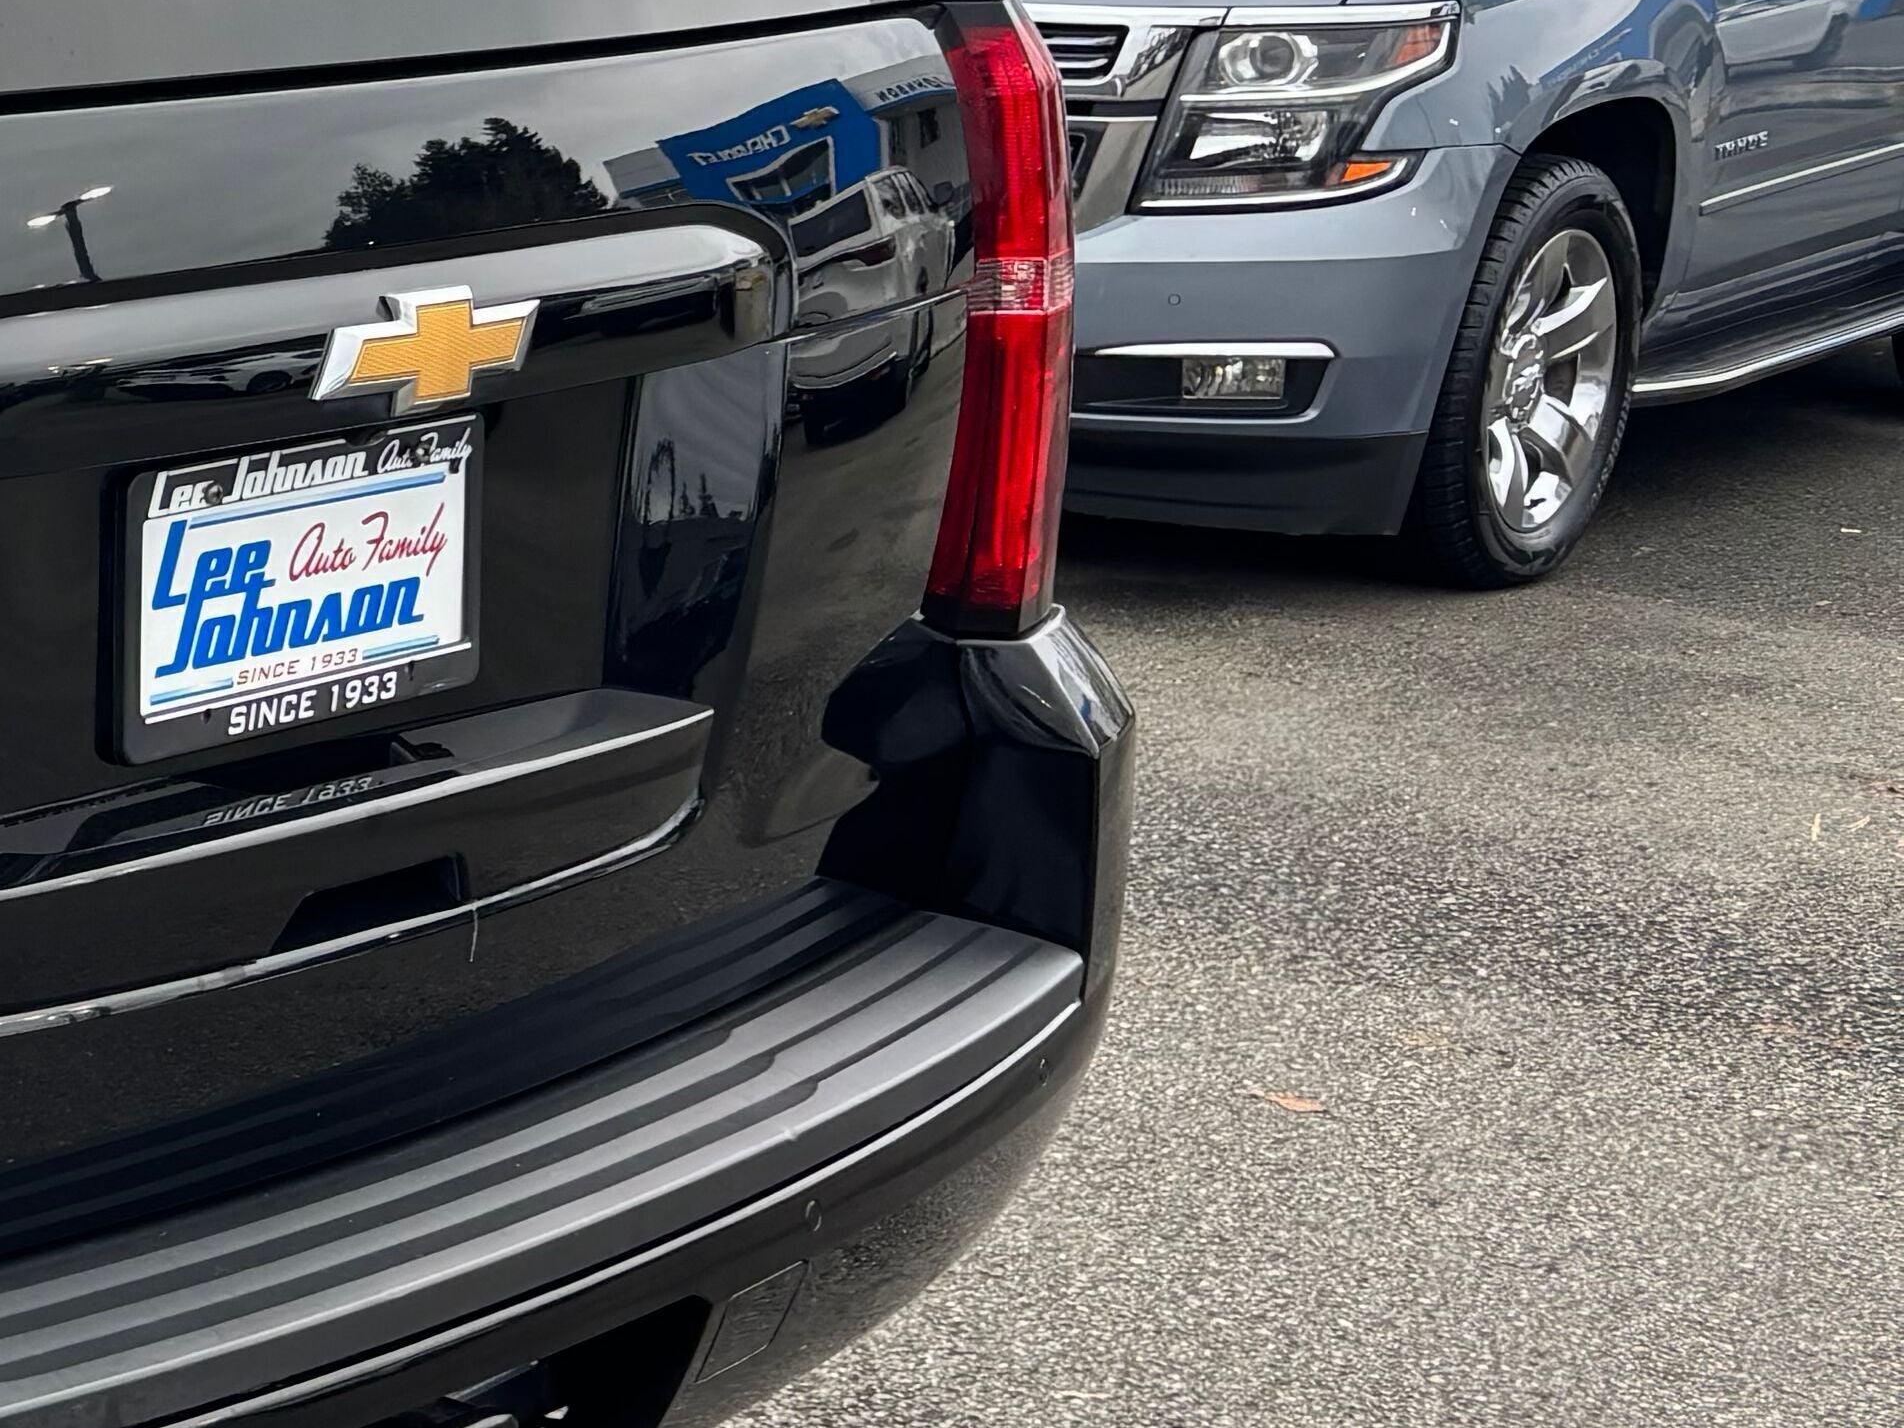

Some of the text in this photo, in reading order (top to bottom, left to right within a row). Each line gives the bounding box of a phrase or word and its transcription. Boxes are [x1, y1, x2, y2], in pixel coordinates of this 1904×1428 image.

[221, 449, 369, 505] Johnson
[152, 502, 448, 610] Lee Auto Family
[153, 570, 425, 679] Johnson
[236, 647, 359, 686] SINCE 1933
[227, 670, 399, 736] SINCE 1933
